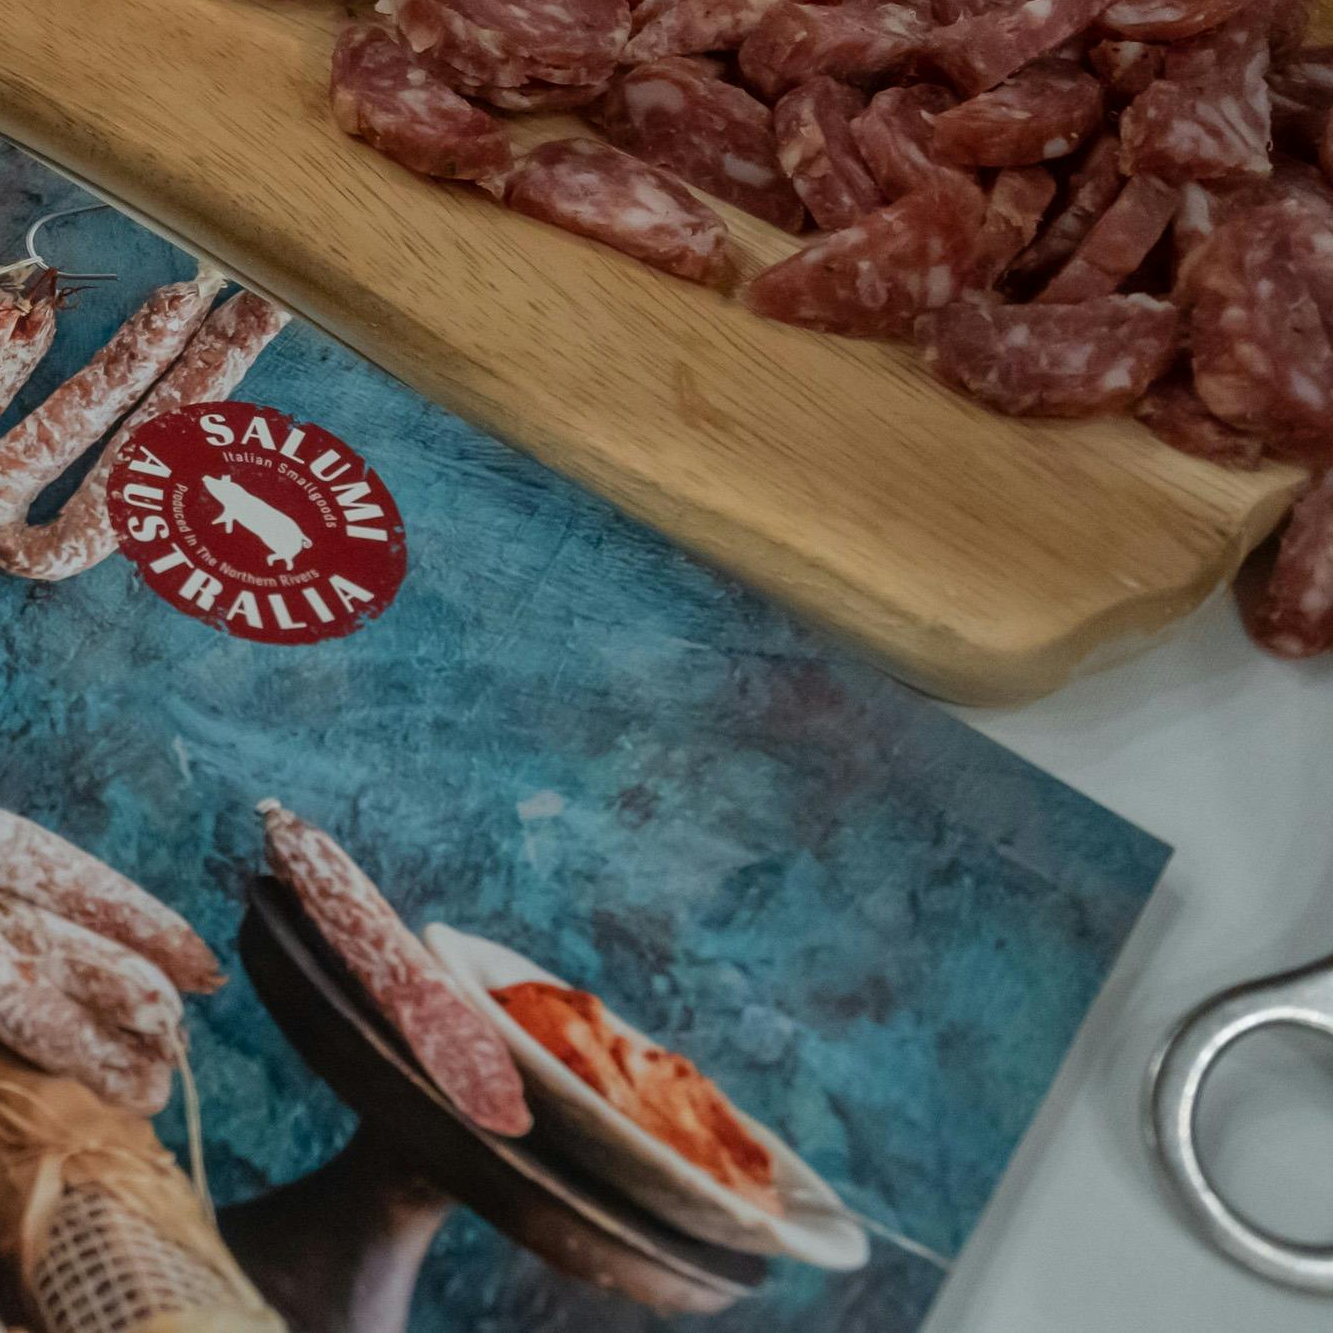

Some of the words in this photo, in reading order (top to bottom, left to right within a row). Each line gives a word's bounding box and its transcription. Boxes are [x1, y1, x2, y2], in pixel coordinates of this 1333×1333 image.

[172, 483, 192, 533] Produced
[196, 546, 218, 566] The
[219, 562, 278, 587] Northern
[279, 569, 320, 587] Rivers
[199, 414, 388, 541] SALUMI
[222, 451, 273, 468] Italian
[277, 462, 338, 528] Smallgoods
[122, 445, 375, 630] AUSTRALIA
